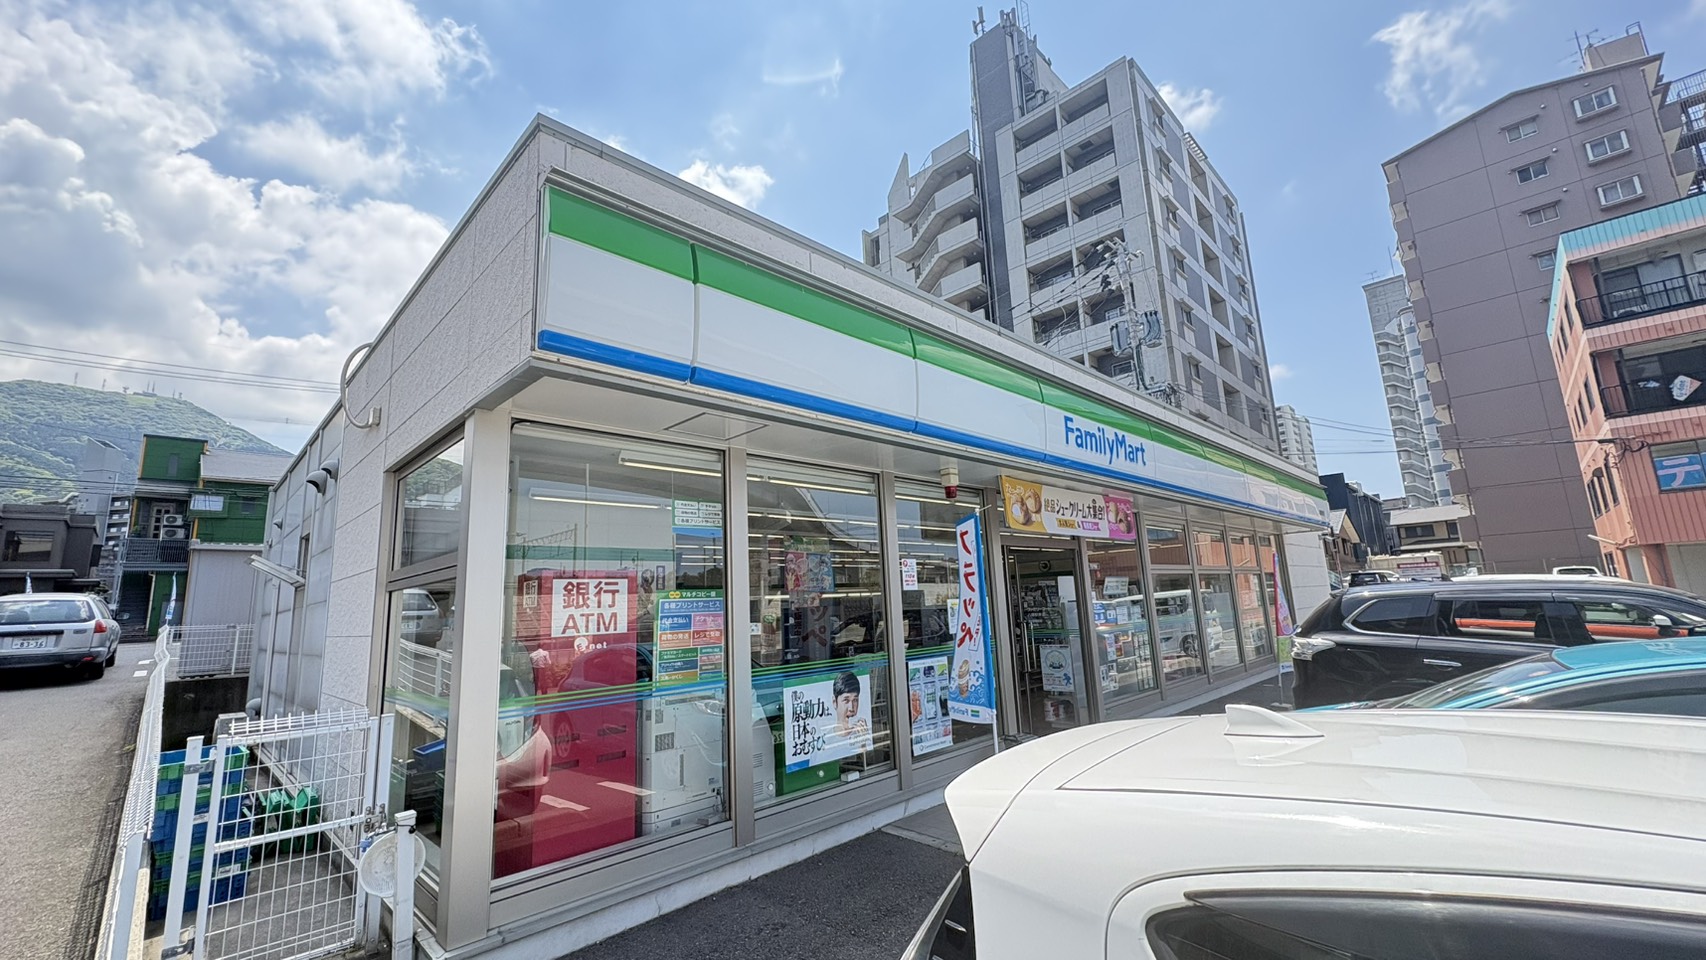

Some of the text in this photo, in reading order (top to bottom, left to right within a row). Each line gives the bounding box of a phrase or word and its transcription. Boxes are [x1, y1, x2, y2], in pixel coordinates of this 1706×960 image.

[1064, 415, 1146, 466] FamilyMart
[1657, 458, 1701, 487] テ
[562, 581, 620, 610] 銀行
[663, 601, 720, 609] 各種プリントサービス
[561, 612, 618, 635] ATM
[792, 721, 817, 741] 日本の
